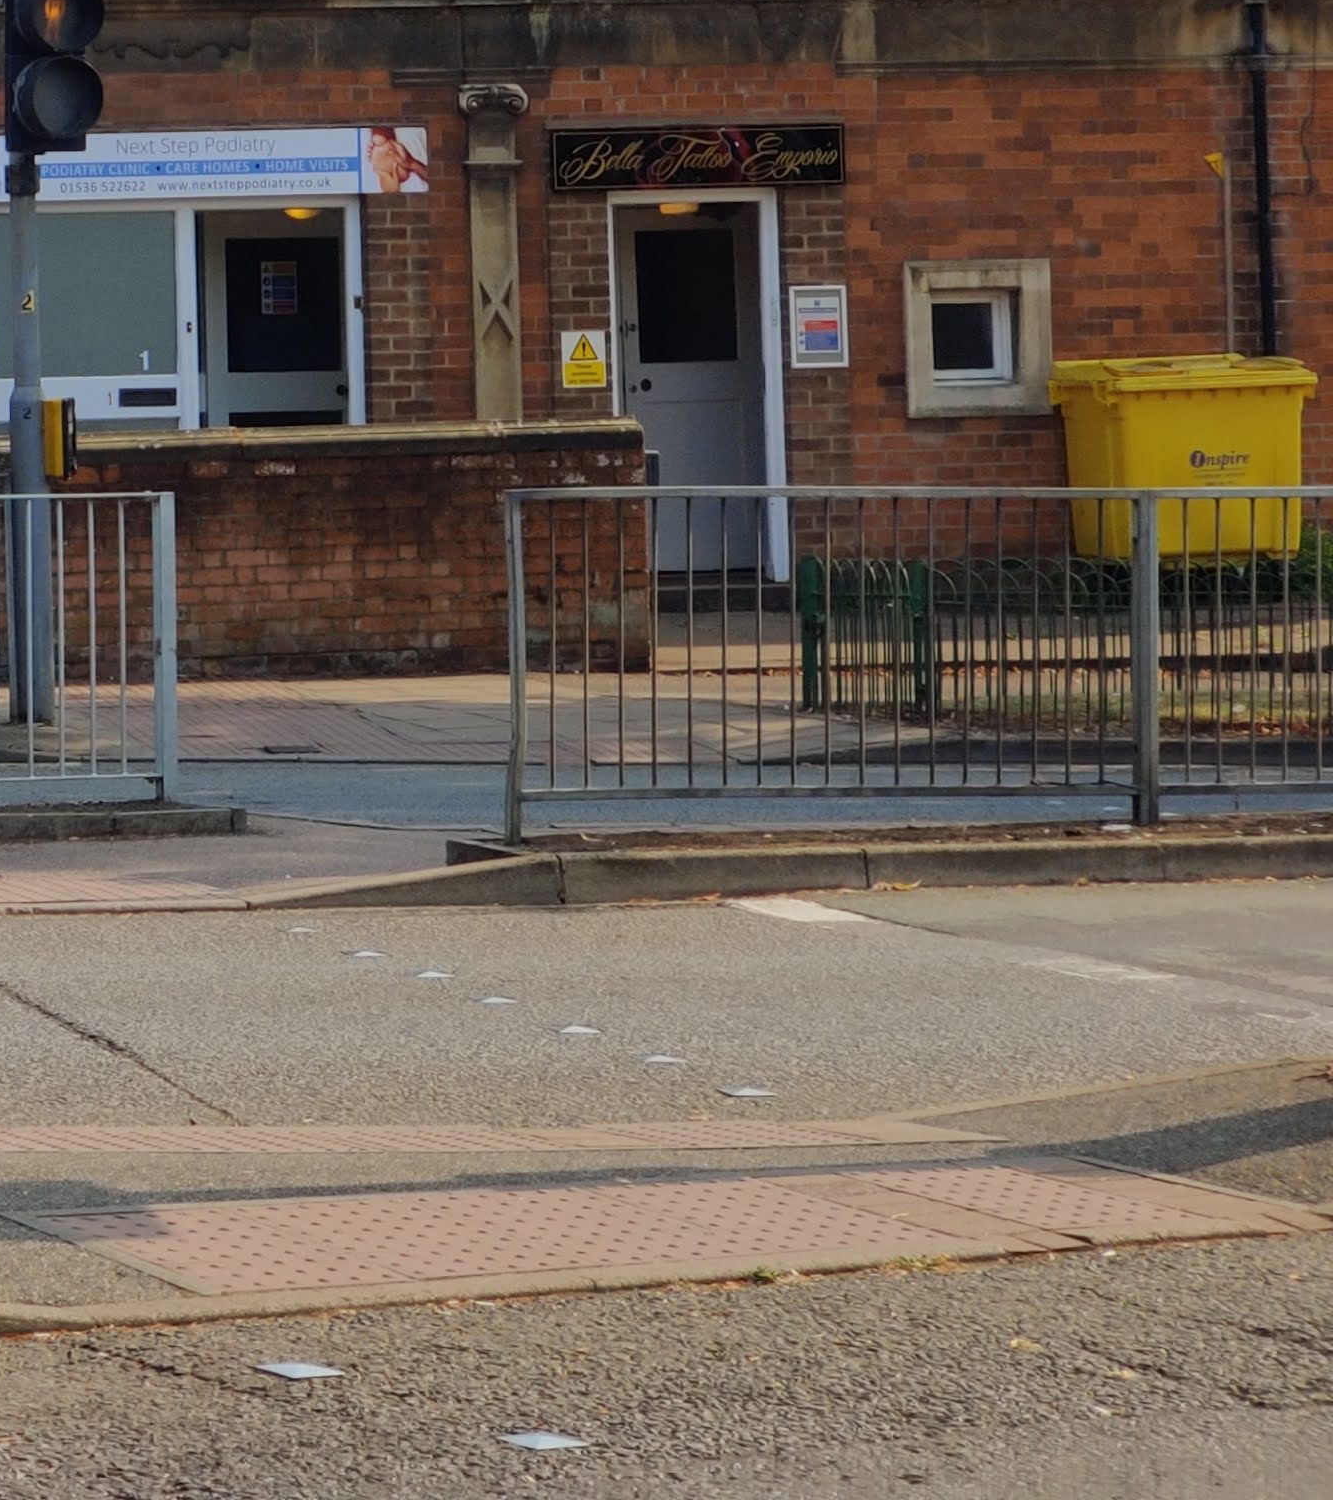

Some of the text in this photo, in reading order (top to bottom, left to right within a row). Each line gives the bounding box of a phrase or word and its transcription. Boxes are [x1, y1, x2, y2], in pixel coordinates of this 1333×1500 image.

[116, 135, 276, 156] Next Step Podiatry
[40, 159, 349, 177] PODIATRY CLINIC CARE HOMES HOME VISITS
[559, 132, 838, 185] Bella Tattoo Emporio
[60, 176, 331, 194] 01536 522622 www.nextsteppodiatry.co.uk
[22, 294, 32, 311] 2
[139, 350, 149, 371] 1
[23, 407, 32, 420] 2
[1190, 450, 1250, 470] Inspire
